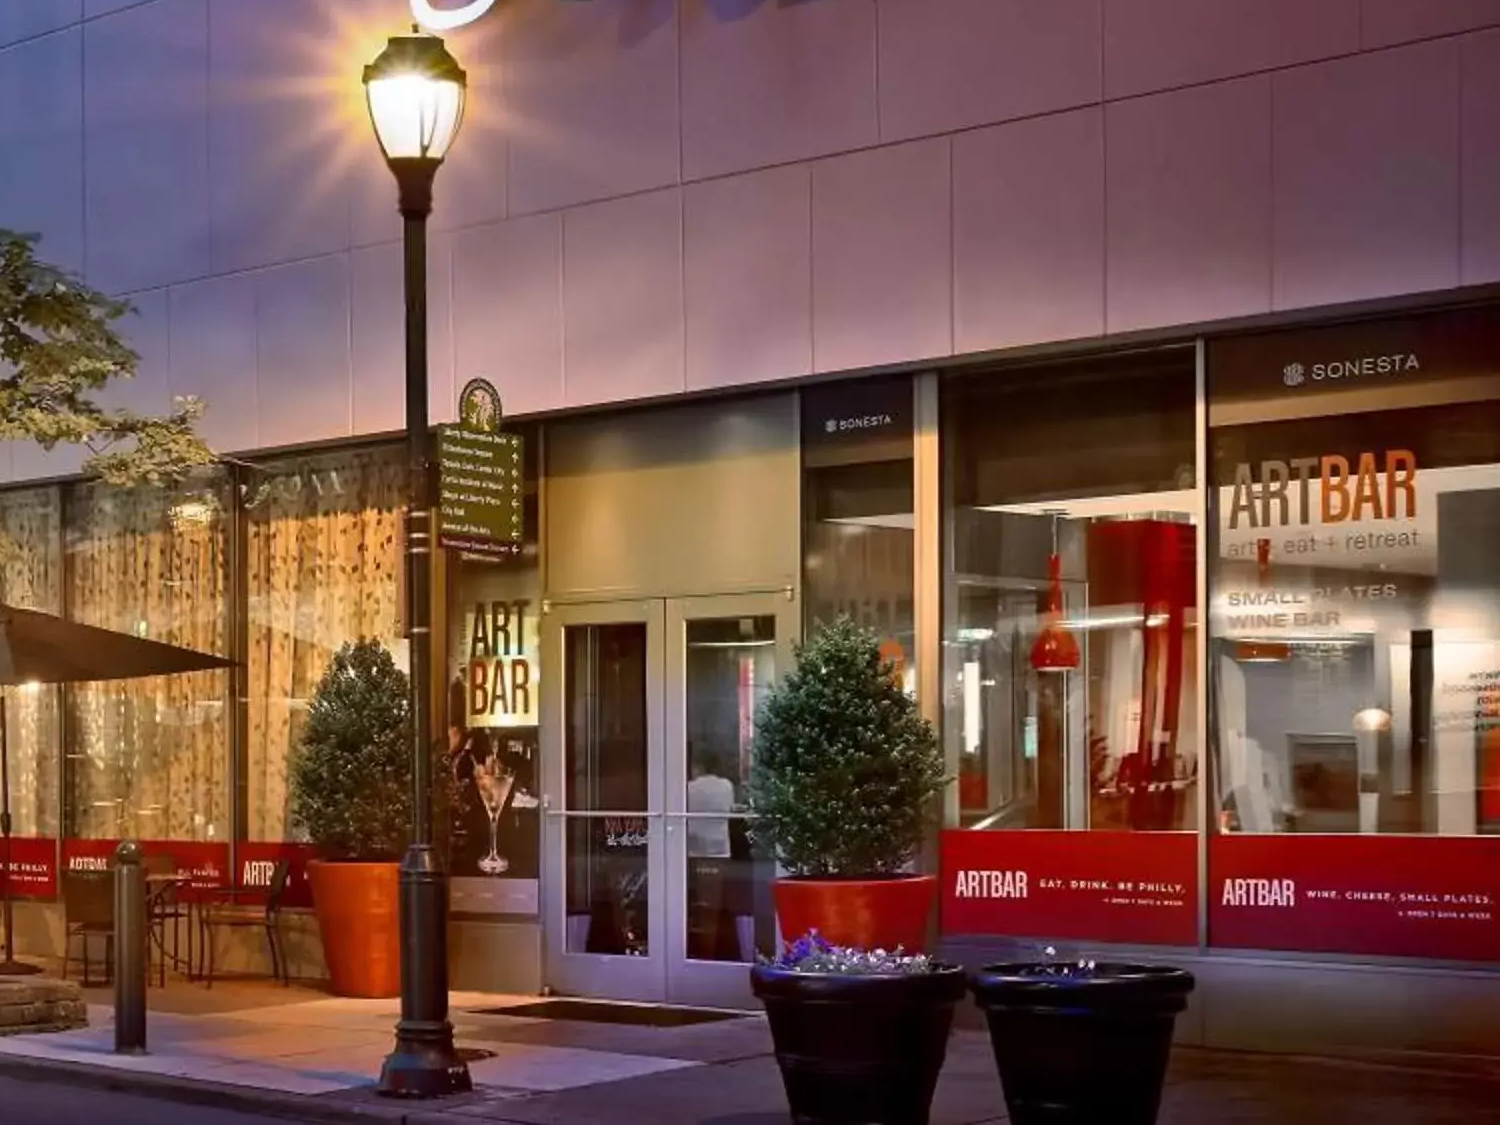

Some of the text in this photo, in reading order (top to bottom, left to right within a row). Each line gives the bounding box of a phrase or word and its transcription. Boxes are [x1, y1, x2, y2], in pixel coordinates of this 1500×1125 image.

[1311, 354, 1420, 380] SONESTA
[839, 415, 891, 430] SONESTA
[1283, 535, 1317, 554] eat
[1346, 530, 1420, 551] retreat
[1228, 590, 1304, 606] SMALL
[1228, 611, 1341, 629] WINE BAR
[955, 870, 1028, 898] ARTBAR
[1222, 878, 1295, 907] ARTBAR
[1399, 892, 1438, 903] SMALL
